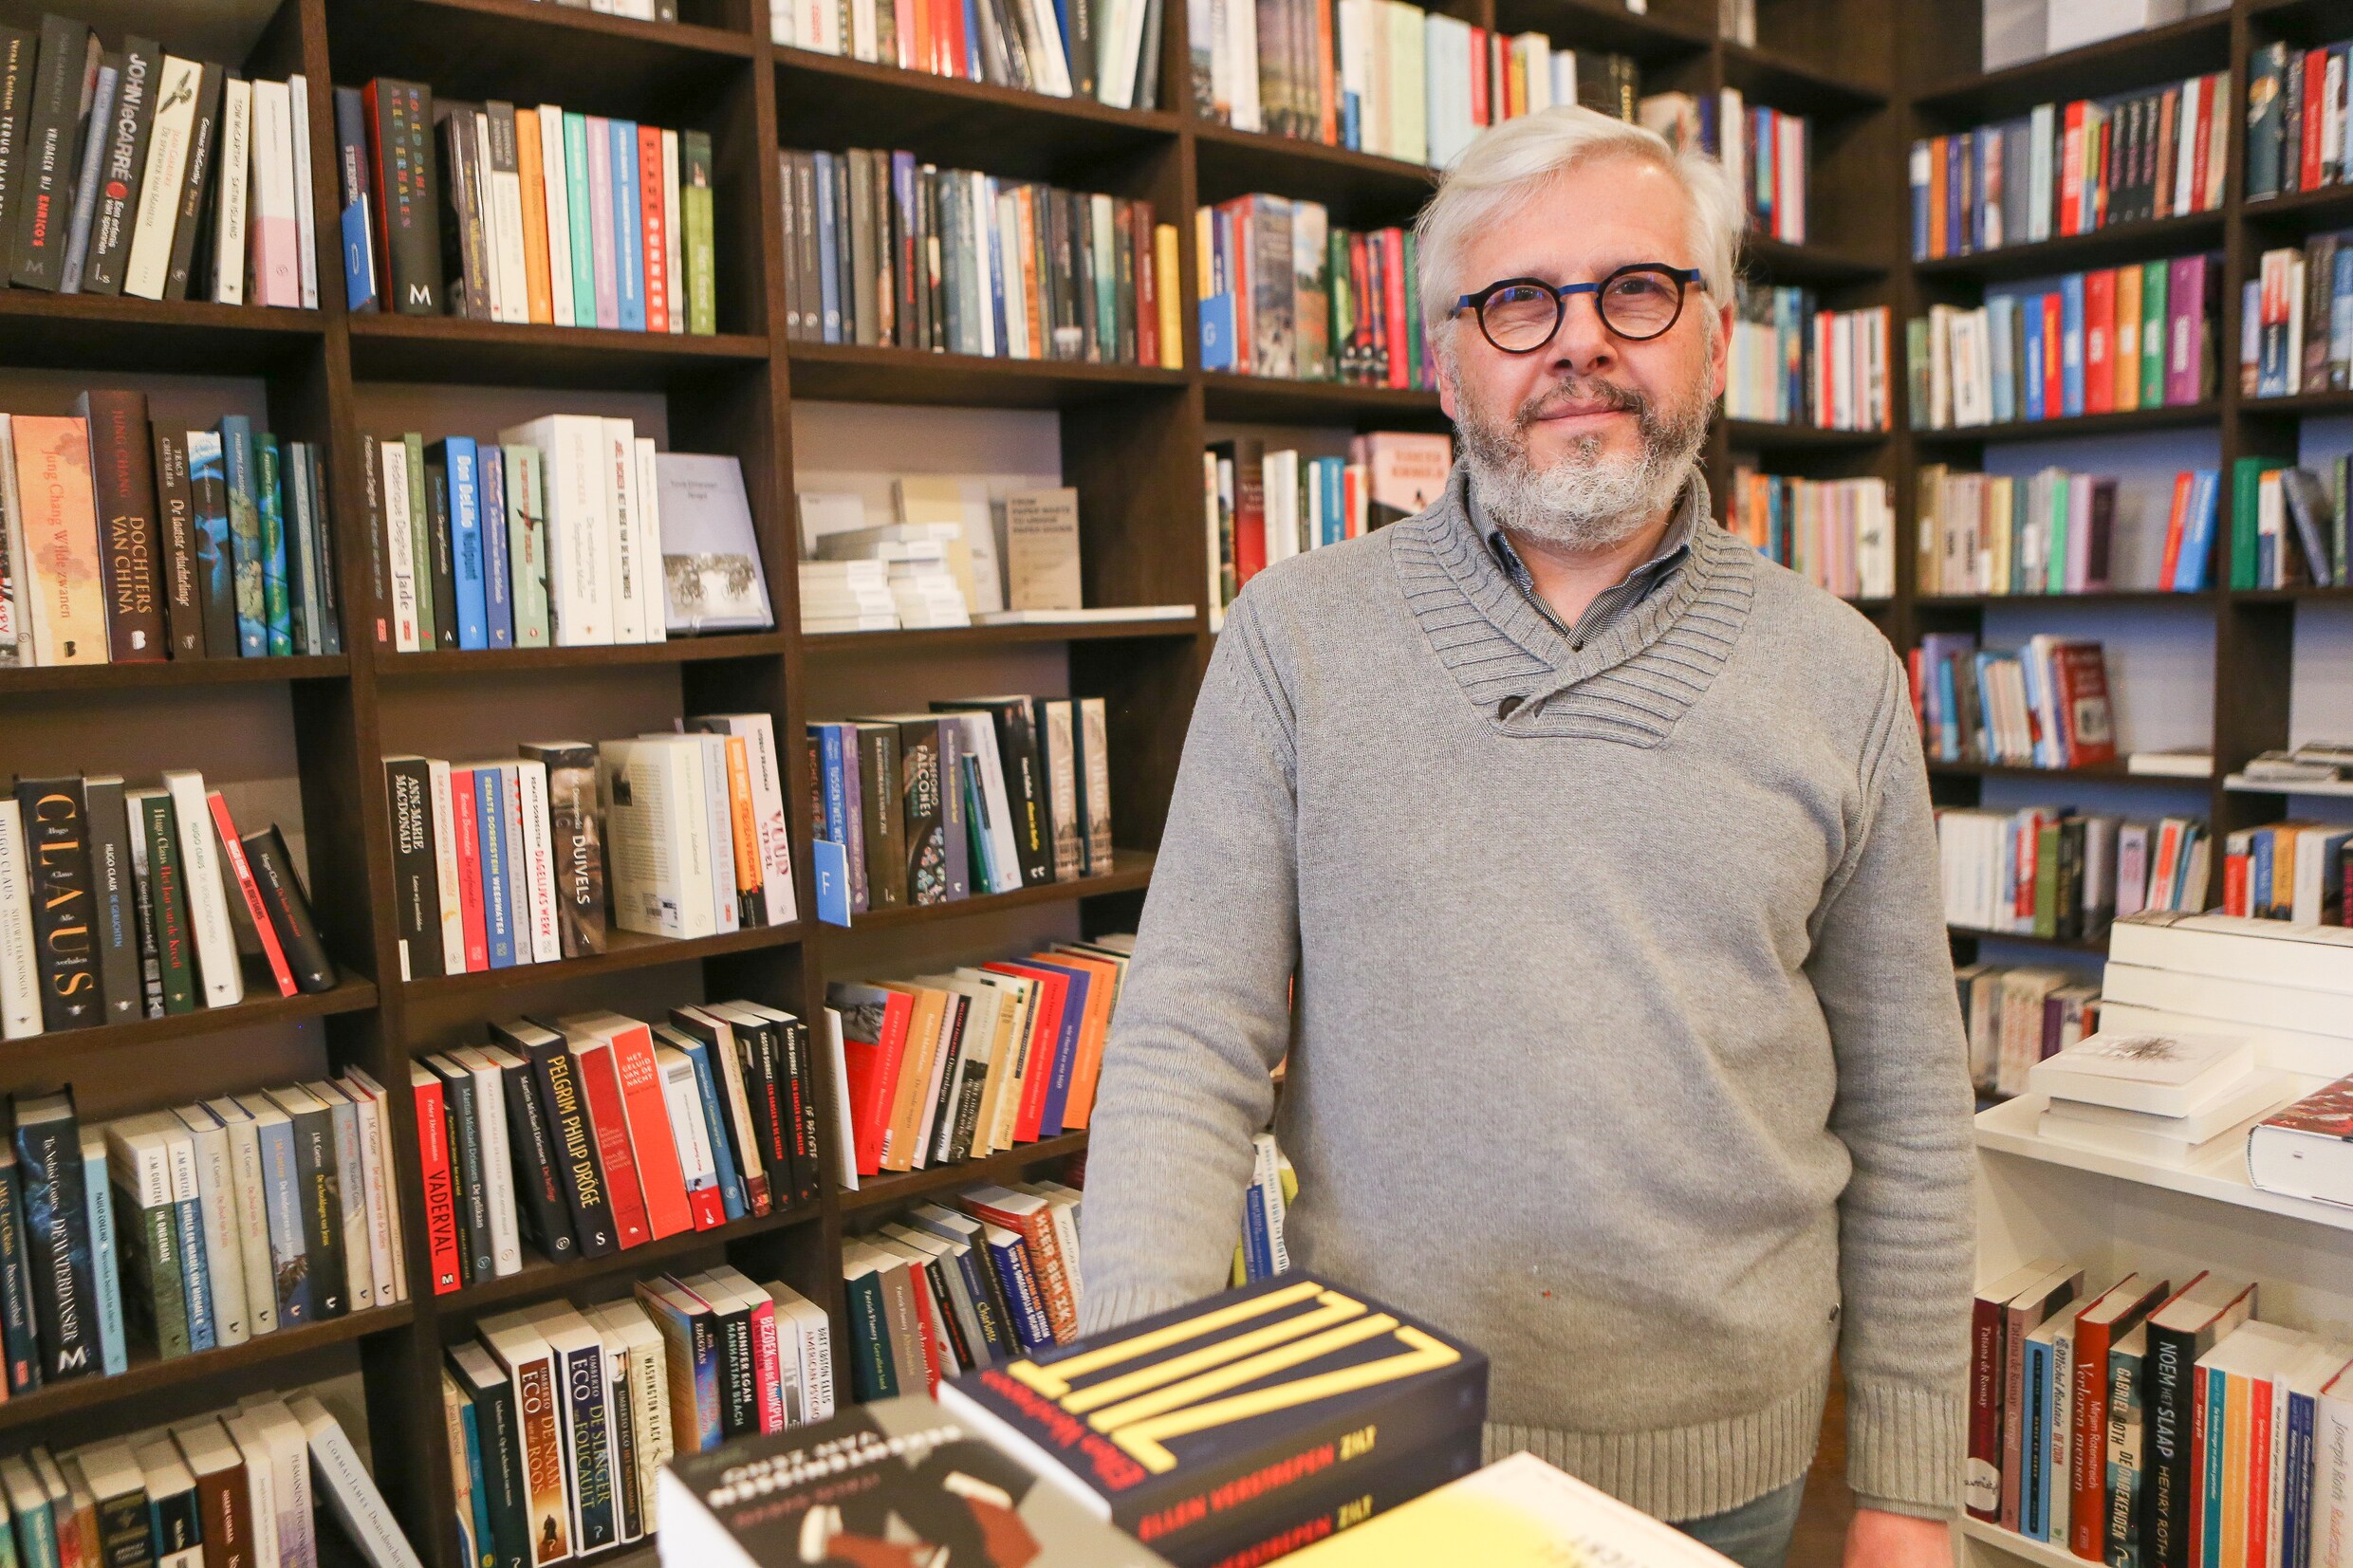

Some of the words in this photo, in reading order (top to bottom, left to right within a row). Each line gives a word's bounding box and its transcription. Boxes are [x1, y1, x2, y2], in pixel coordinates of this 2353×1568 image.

[103, 199, 114, 213] van
[111, 200, 123, 216] Een
[98, 215, 111, 254] spionnen
[108, 217, 120, 248] erfenis
[42, 450, 61, 479] Jung
[457, 455, 472, 481] Don
[46, 484, 66, 526] Chang
[171, 500, 185, 514] De
[460, 484, 474, 527] DeLillo
[54, 530, 68, 568] Wilde
[112, 517, 131, 549] VAN
[172, 517, 187, 548] laatste
[129, 517, 152, 614] DOCHTERS
[462, 531, 477, 581] Nulpunt
[57, 572, 73, 618] zwanen
[115, 556, 134, 614] CHINA
[174, 551, 191, 607] vluchtelinge
[396, 572, 412, 610] Jade
[809, 749, 819, 787] MICHEL
[917, 746, 931, 817] FALCONES
[395, 775, 412, 853] MACDONALD
[408, 778, 424, 849] ANN-MARIE
[485, 777, 493, 812] RENATE
[154, 809, 168, 836] Hugo
[105, 844, 116, 866] HUGO
[157, 838, 170, 864] Claus
[487, 816, 499, 875] DORRESTEIN
[107, 869, 118, 891] CLAUS
[160, 867, 174, 883] Het
[535, 850, 548, 905] DAGELIJKS
[572, 835, 590, 904] DUIVELS
[161, 885, 175, 904] Jaar
[491, 877, 505, 934] WEERWATER
[165, 908, 175, 924] van
[167, 926, 177, 936] de
[540, 909, 550, 936] WERK
[169, 940, 181, 968] Kreeft
[462, 1088, 472, 1113] Martin
[547, 1056, 578, 1115] PELGRIM
[939, 1057, 959, 1103] Onverslagen
[466, 1116, 474, 1143] Michael
[520, 1076, 530, 1101] Martin
[526, 1102, 537, 1130] Michael
[532, 1132, 546, 1164] Driessen
[562, 1117, 587, 1159] PHILIP
[469, 1144, 477, 1181] Driessen
[472, 1185, 480, 1194] De
[572, 1162, 600, 1208] DRÖGE
[157, 1211, 166, 1220] IN
[428, 1171, 453, 1256] VADERVAL
[471, 1196, 483, 1227] pelikaan
[157, 1222, 171, 1263] ONGENADE
[1034, 1214, 1052, 1257] HIER
[1045, 1261, 1065, 1295] BEN
[1055, 1299, 1071, 1324] IK
[759, 1316, 776, 1355] BEZOEK
[977, 1301, 997, 1343] Charlotte
[1980, 1326, 1991, 1355] Tatiana
[695, 1323, 707, 1364] EDUGYAN
[737, 1321, 749, 1370] JENNIFER
[806, 1330, 817, 1381] AMERICAN
[2158, 1342, 2176, 1386] NOEM
[571, 1359, 589, 1401] ECO
[589, 1356, 600, 1397] UMBERTO
[644, 1357, 658, 1411] WASHINGTON
[727, 1323, 739, 1390] MANHATTAN
[733, 1393, 743, 1426] BEACH
[1980, 1358, 1989, 1372] de
[522, 1373, 541, 1413] ECO
[540, 1367, 551, 1410] UMBERTO
[742, 1373, 751, 1402] EGAN
[821, 1379, 832, 1404] ELLIS
[1978, 1374, 1989, 1408] Rosnay
[2077, 1362, 2095, 1427] Verloren
[2114, 1368, 2131, 1411] GABRIEL
[541, 1416, 556, 1439] DE
[589, 1405, 603, 1427] DE
[648, 1415, 660, 1443] BLACK
[2090, 1401, 2102, 1431] Mirjam
[2157, 1407, 2176, 1457] SLAAP
[2075, 1433, 2084, 1490] mensen
[2121, 1451, 2134, 1465] DE
[2331, 1419, 2348, 1467] Joseph
[529, 1447, 545, 1495] ROOS
[544, 1440, 560, 1488] NAAM
[575, 1422, 595, 1509] FOUCAULT
[592, 1430, 611, 1504] SLINGER
[1139, 1493, 1207, 1542] ELLEN
[1210, 1442, 1335, 1511] VERSTREPEN
[2113, 1468, 2131, 1540] ONBEKENDEN
[2158, 1465, 2170, 1515] HENRY
[2331, 1470, 2345, 1501] Roth
[2158, 1519, 2169, 1558] ROTH
